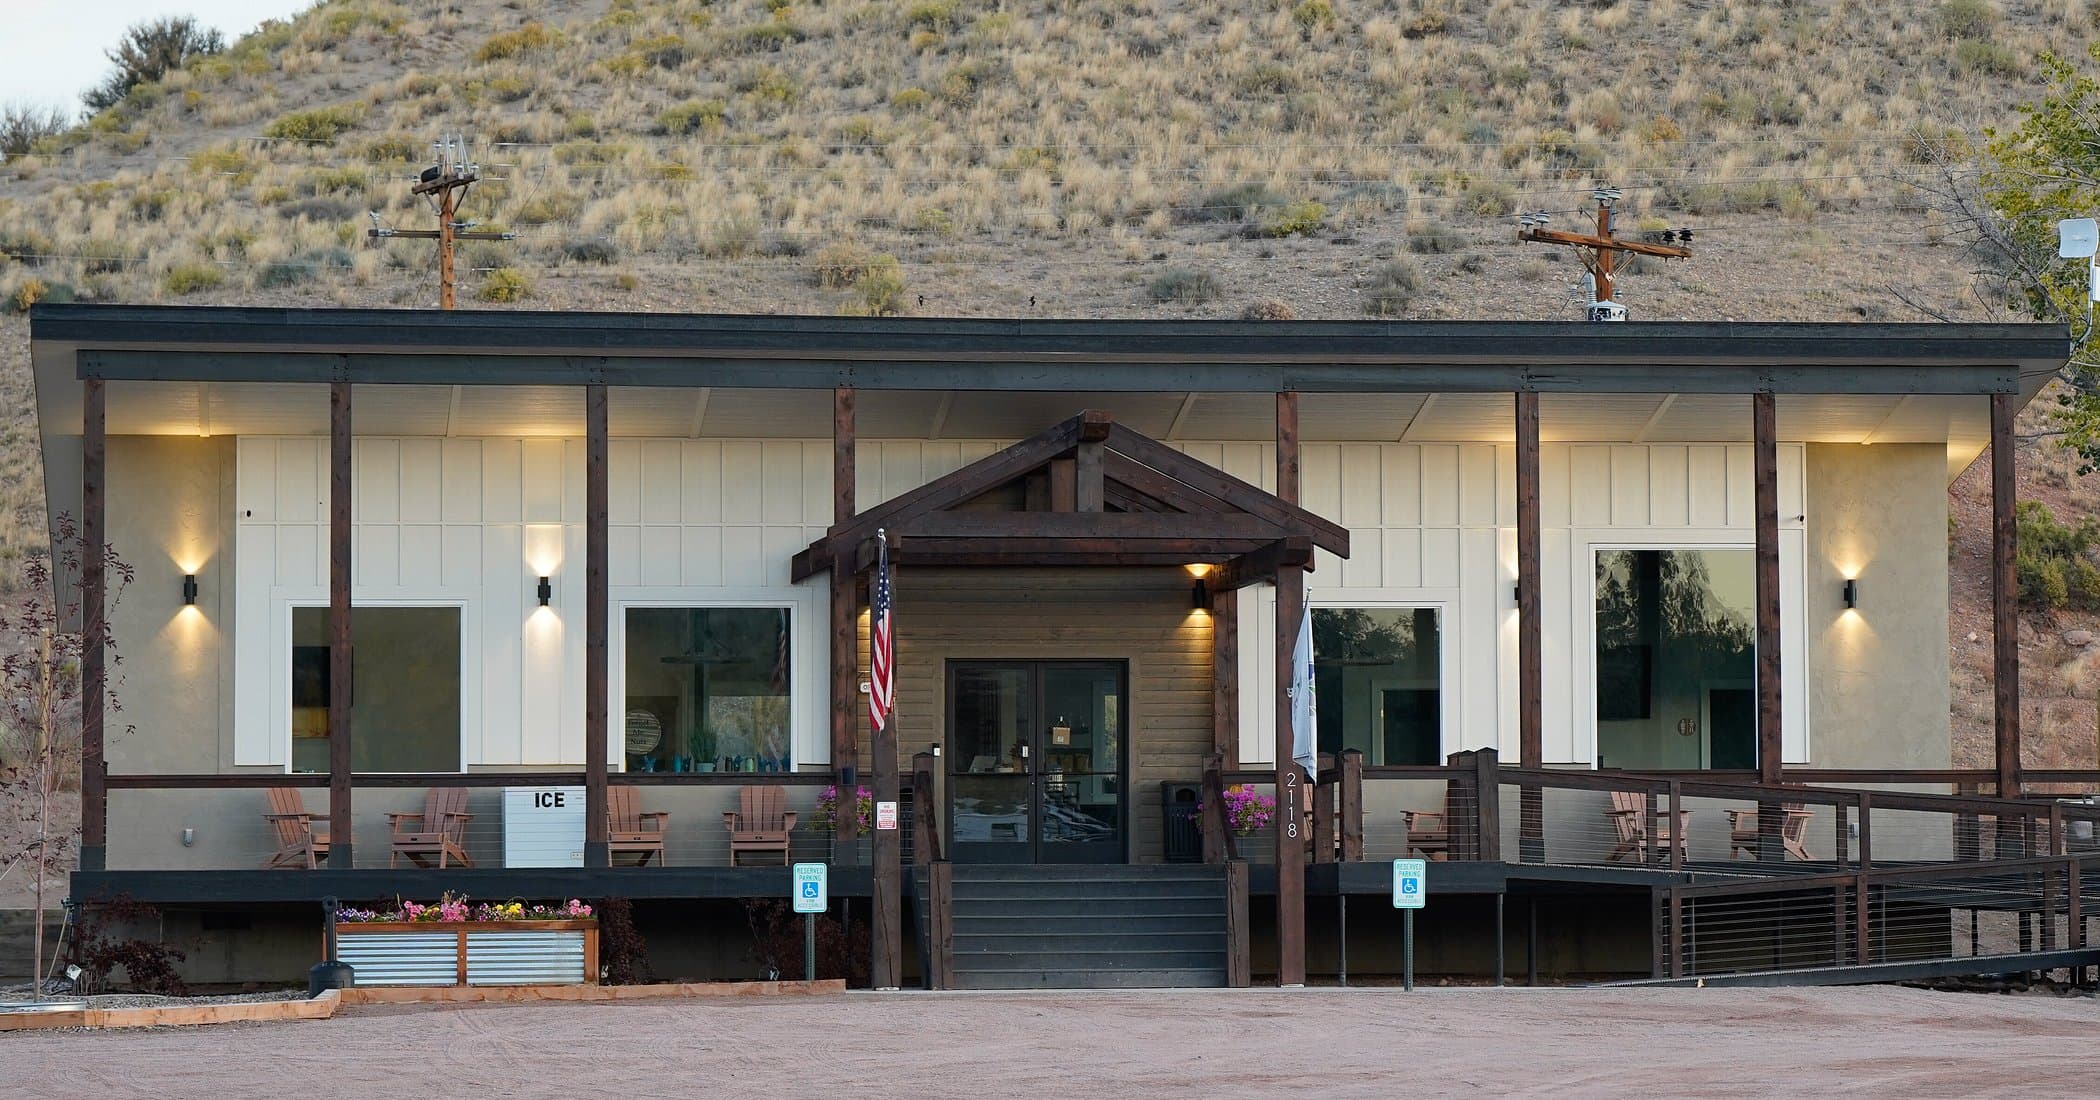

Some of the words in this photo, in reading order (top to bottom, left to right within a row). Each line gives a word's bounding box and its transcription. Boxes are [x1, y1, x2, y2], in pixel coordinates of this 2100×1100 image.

[535, 792, 565, 808] ICE
[1286, 772, 1297, 838] 2118
[796, 867, 824, 875] RESERVED
